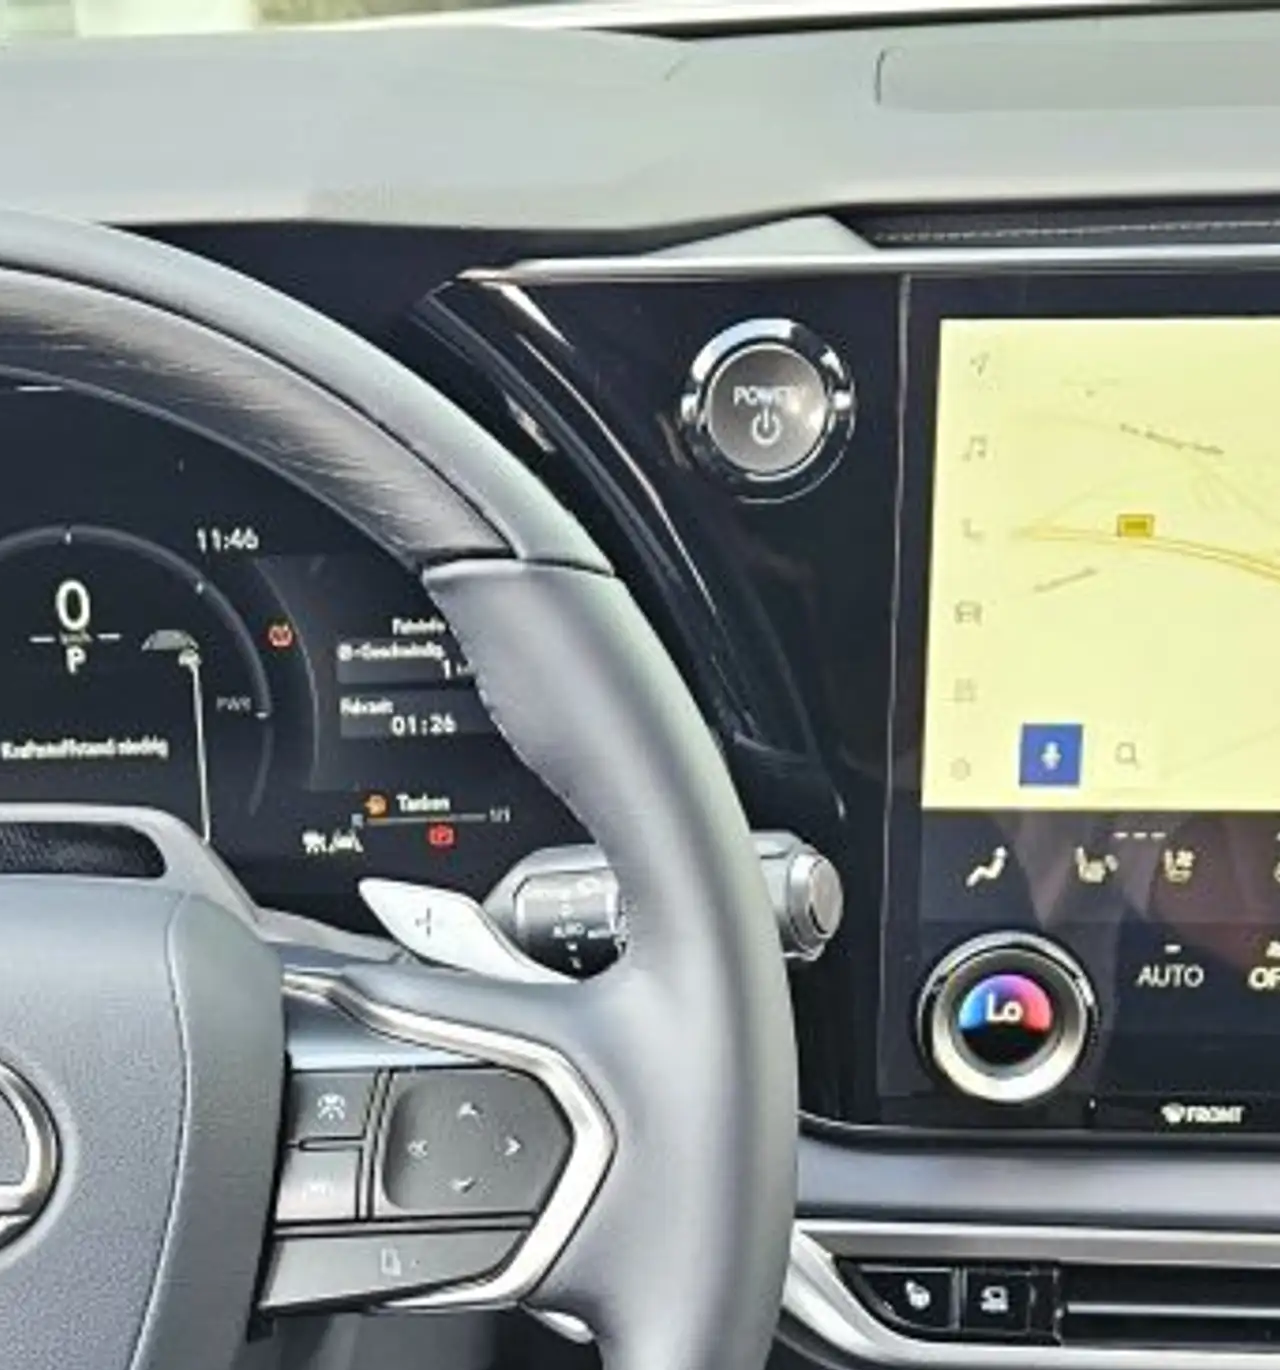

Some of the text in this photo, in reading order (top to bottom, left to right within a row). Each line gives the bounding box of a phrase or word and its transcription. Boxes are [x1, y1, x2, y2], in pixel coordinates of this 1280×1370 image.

[197, 527, 259, 551] 11:46
[55, 580, 91, 631] 0
[66, 646, 87, 674] P
[391, 713, 457, 737] 01:26
[1136, 963, 1204, 987] AUTO
[985, 991, 1024, 1023] Lo
[1186, 1105, 1245, 1124] FRONT
